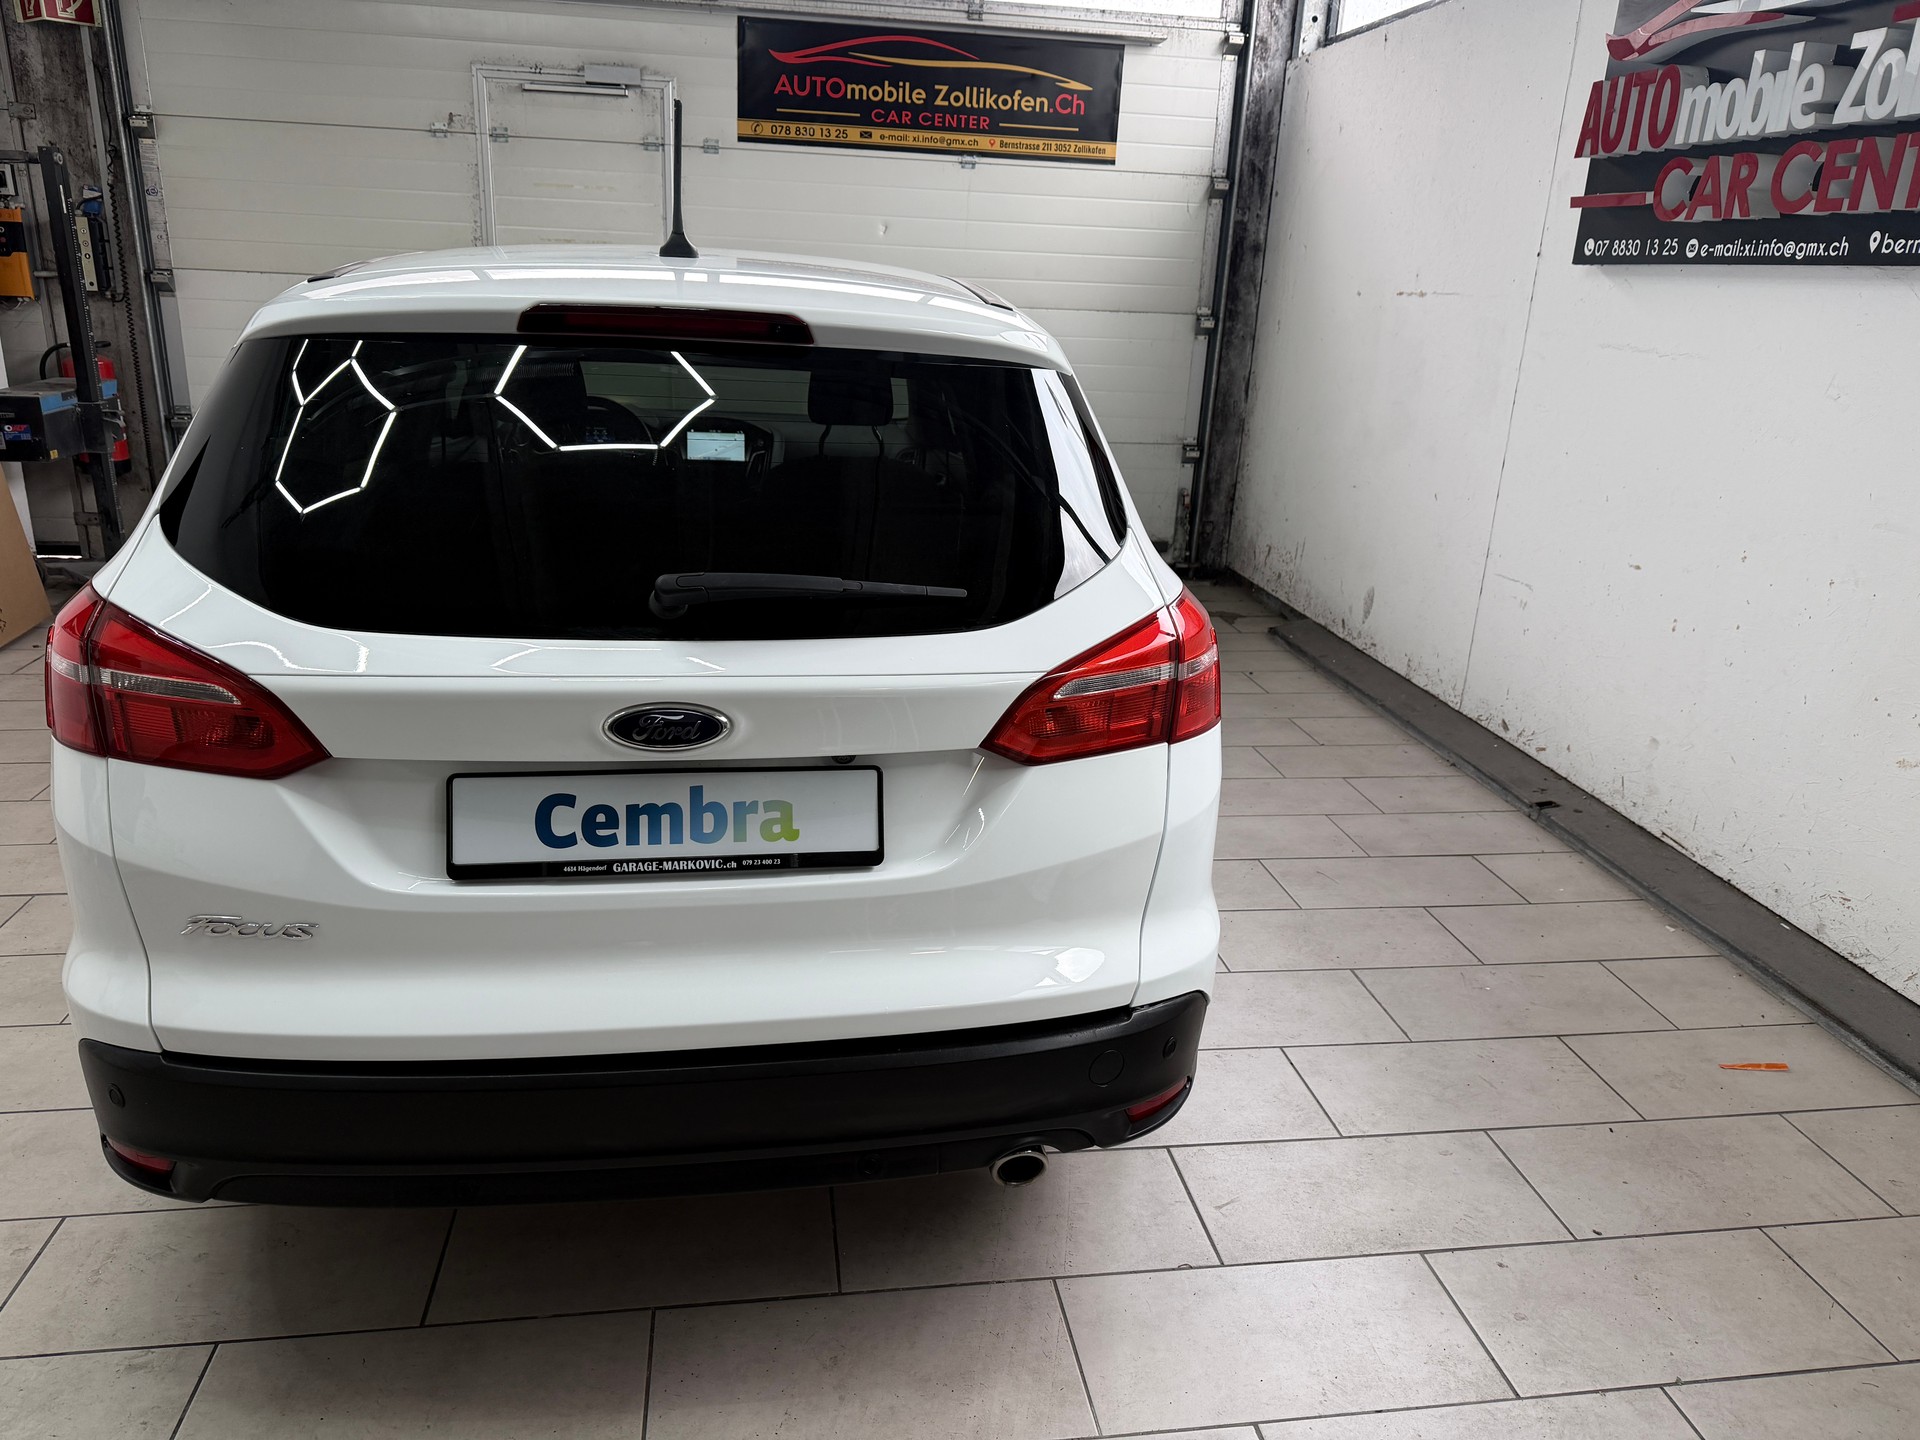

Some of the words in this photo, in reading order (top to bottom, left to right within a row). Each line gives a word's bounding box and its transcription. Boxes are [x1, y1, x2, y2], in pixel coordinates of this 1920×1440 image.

[774, 74, 926, 104] AUTOmobile
[1574, 41, 1825, 158] AUTOmobile
[871, 108, 913, 125] CAR
[918, 112, 990, 130] CENTER
[770, 124, 791, 136] 078
[794, 126, 815, 138] 830
[820, 127, 832, 139] 13
[834, 128, 848, 140] 25
[999, 140, 1040, 152] Bernstrasse
[1055, 143, 1072, 153] 3052
[1073, 145, 1107, 155] Zollikofen
[1653, 153, 1758, 221] CAR
[1595, 240, 1609, 256] 07
[1611, 239, 1641, 256] 8830
[1645, 239, 1660, 256] 13
[1662, 238, 1679, 256] 25
[632, 713, 701, 741] Ford
[534, 785, 800, 849] Cembra
[612, 859, 737, 873] GARAGE-MARKOVIC.ch
